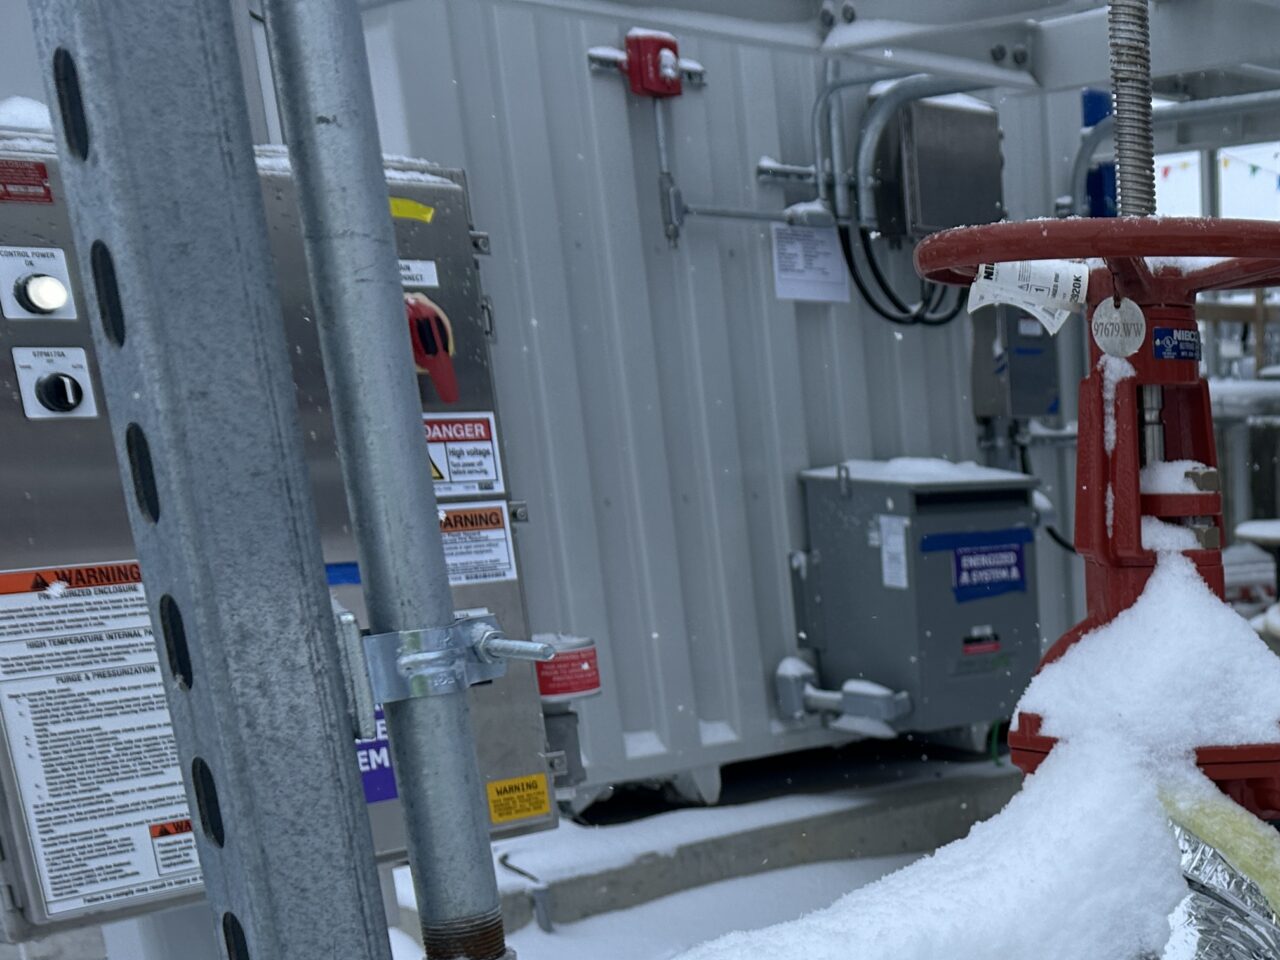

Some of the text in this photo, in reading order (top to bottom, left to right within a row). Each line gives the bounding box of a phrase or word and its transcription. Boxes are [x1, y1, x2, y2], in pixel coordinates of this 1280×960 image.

[440, 511, 500, 529] ARNING
[54, 563, 141, 587] WARNING
[93, 584, 138, 595] ENCLOSURE
[49, 633, 104, 647] TEMPERATURE
[106, 630, 142, 641] INTERNAL
[56, 675, 83, 684] PURGE
[92, 665, 156, 680] PRESSURIZATION
[356, 747, 390, 772] EM
[495, 780, 538, 797] WARNING
